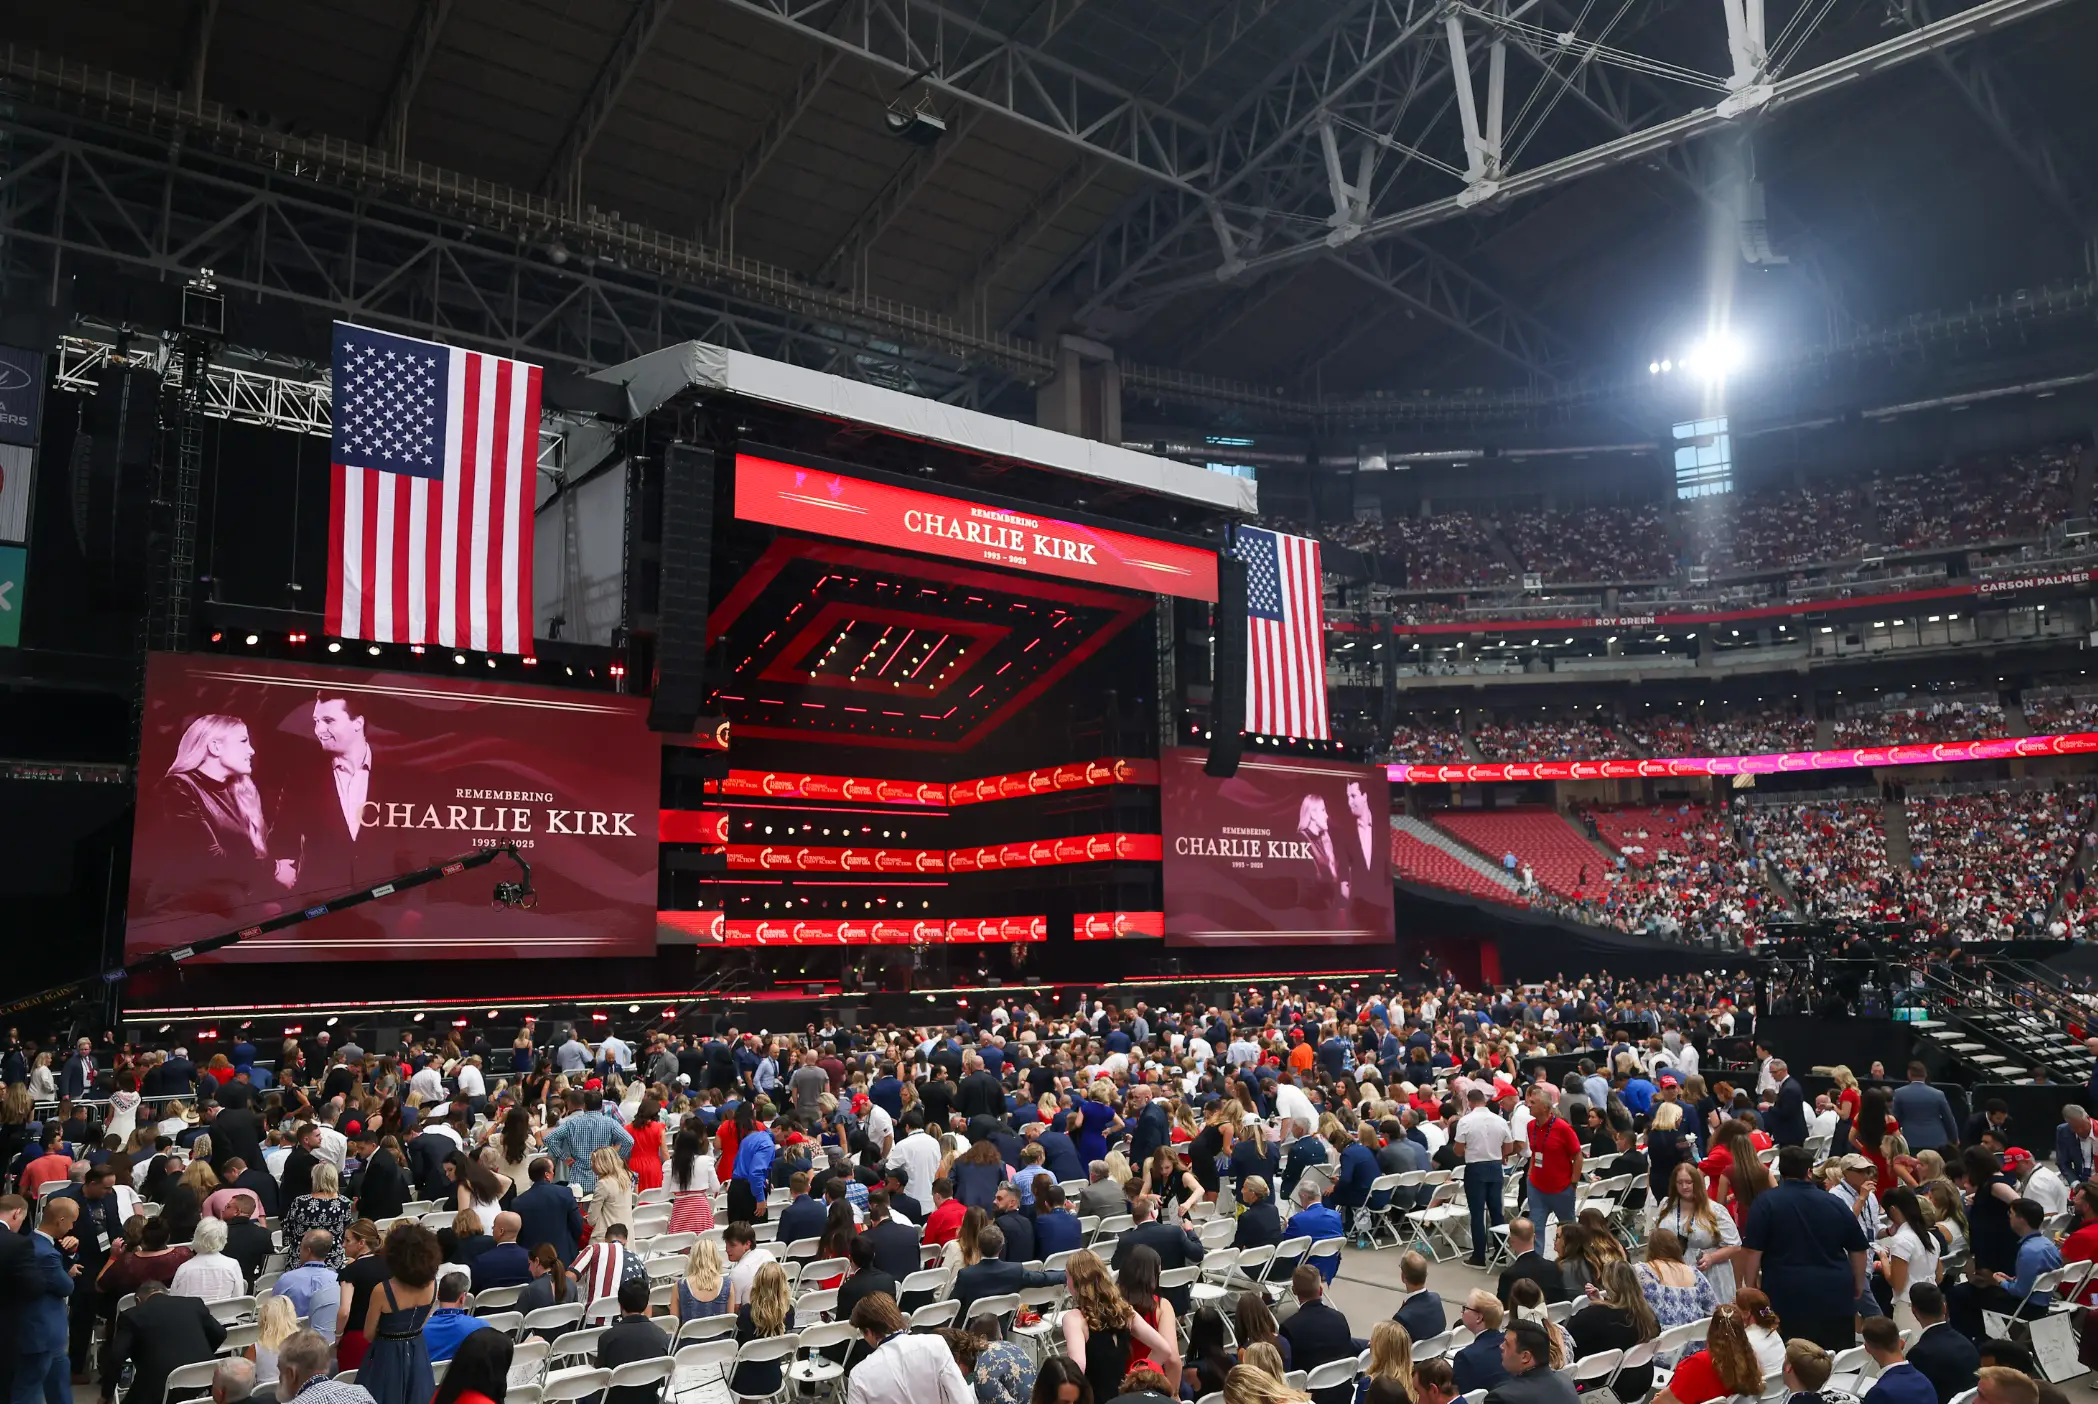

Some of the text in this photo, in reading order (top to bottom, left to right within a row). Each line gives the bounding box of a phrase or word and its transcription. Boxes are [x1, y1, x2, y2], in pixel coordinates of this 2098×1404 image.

[971, 508, 1039, 529] REMEMBERING
[904, 510, 1098, 565] CHARLIE KIRK
[1009, 555, 1027, 565] 2025
[1980, 579, 2034, 592] CARSON
[2037, 572, 2090, 586] PALMER
[1595, 618, 1617, 626] ROY
[1620, 617, 1655, 625] GREEN
[456, 788, 554, 802] REMEMBERING
[358, 801, 637, 837] CHARLIE KIRK
[1222, 826, 1271, 836] REMEMBERING
[472, 838, 497, 848] 1993
[1175, 837, 1314, 860] CHARLIE KIRK
